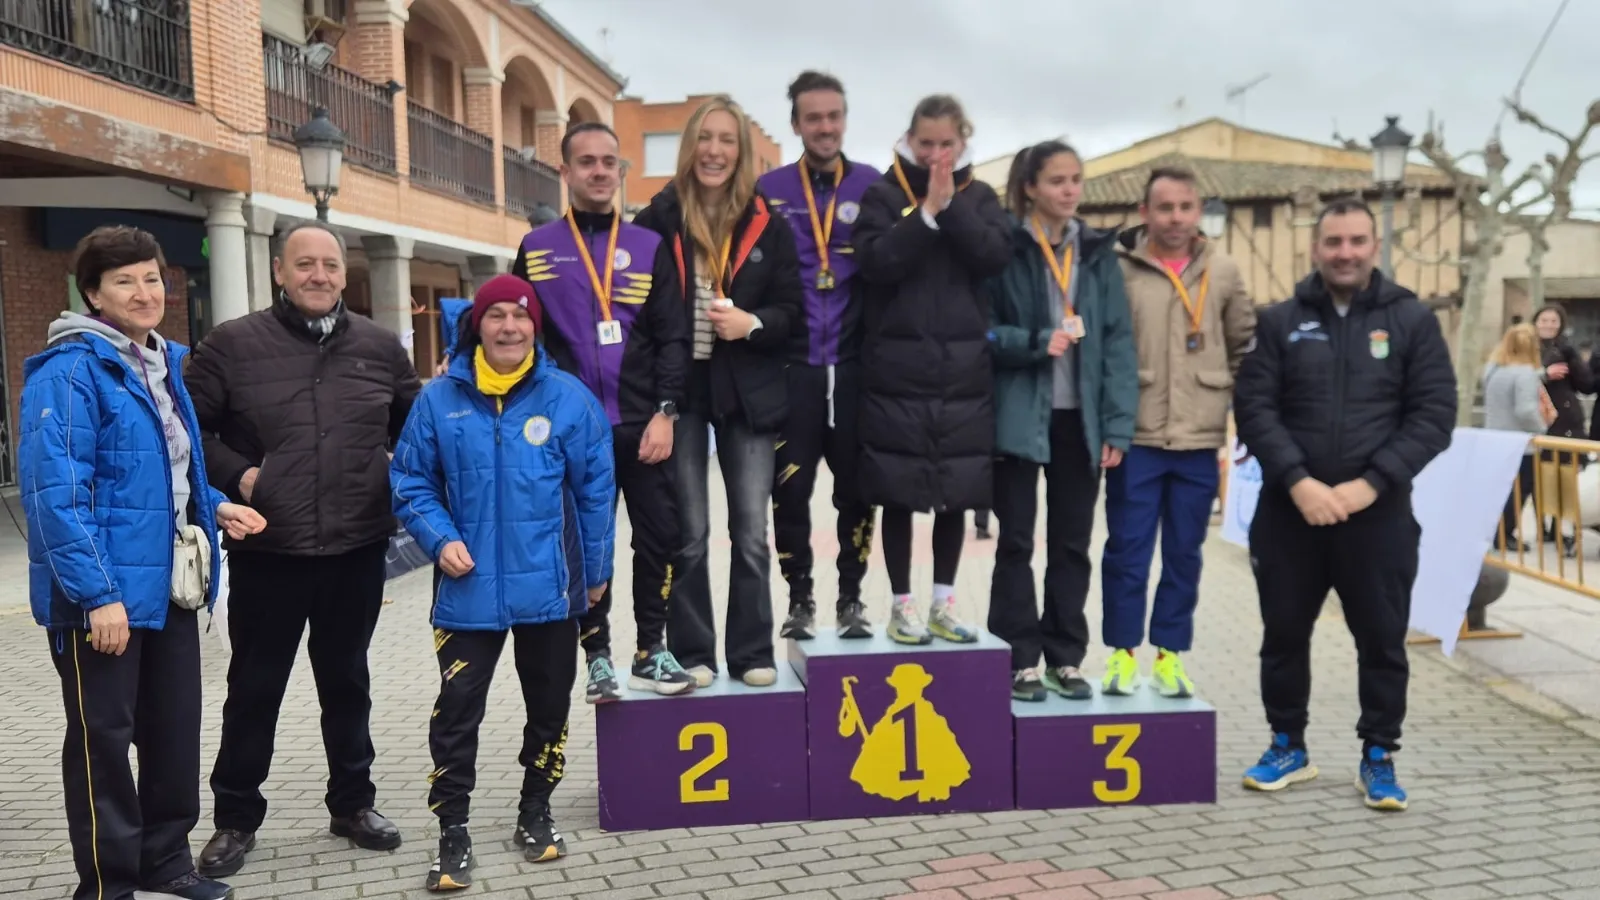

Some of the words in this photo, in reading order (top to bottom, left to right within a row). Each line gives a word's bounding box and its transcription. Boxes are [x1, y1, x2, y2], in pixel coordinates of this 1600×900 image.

[679, 722, 730, 803] 2
[892, 702, 924, 781] 1
[1093, 723, 1142, 803] 3
